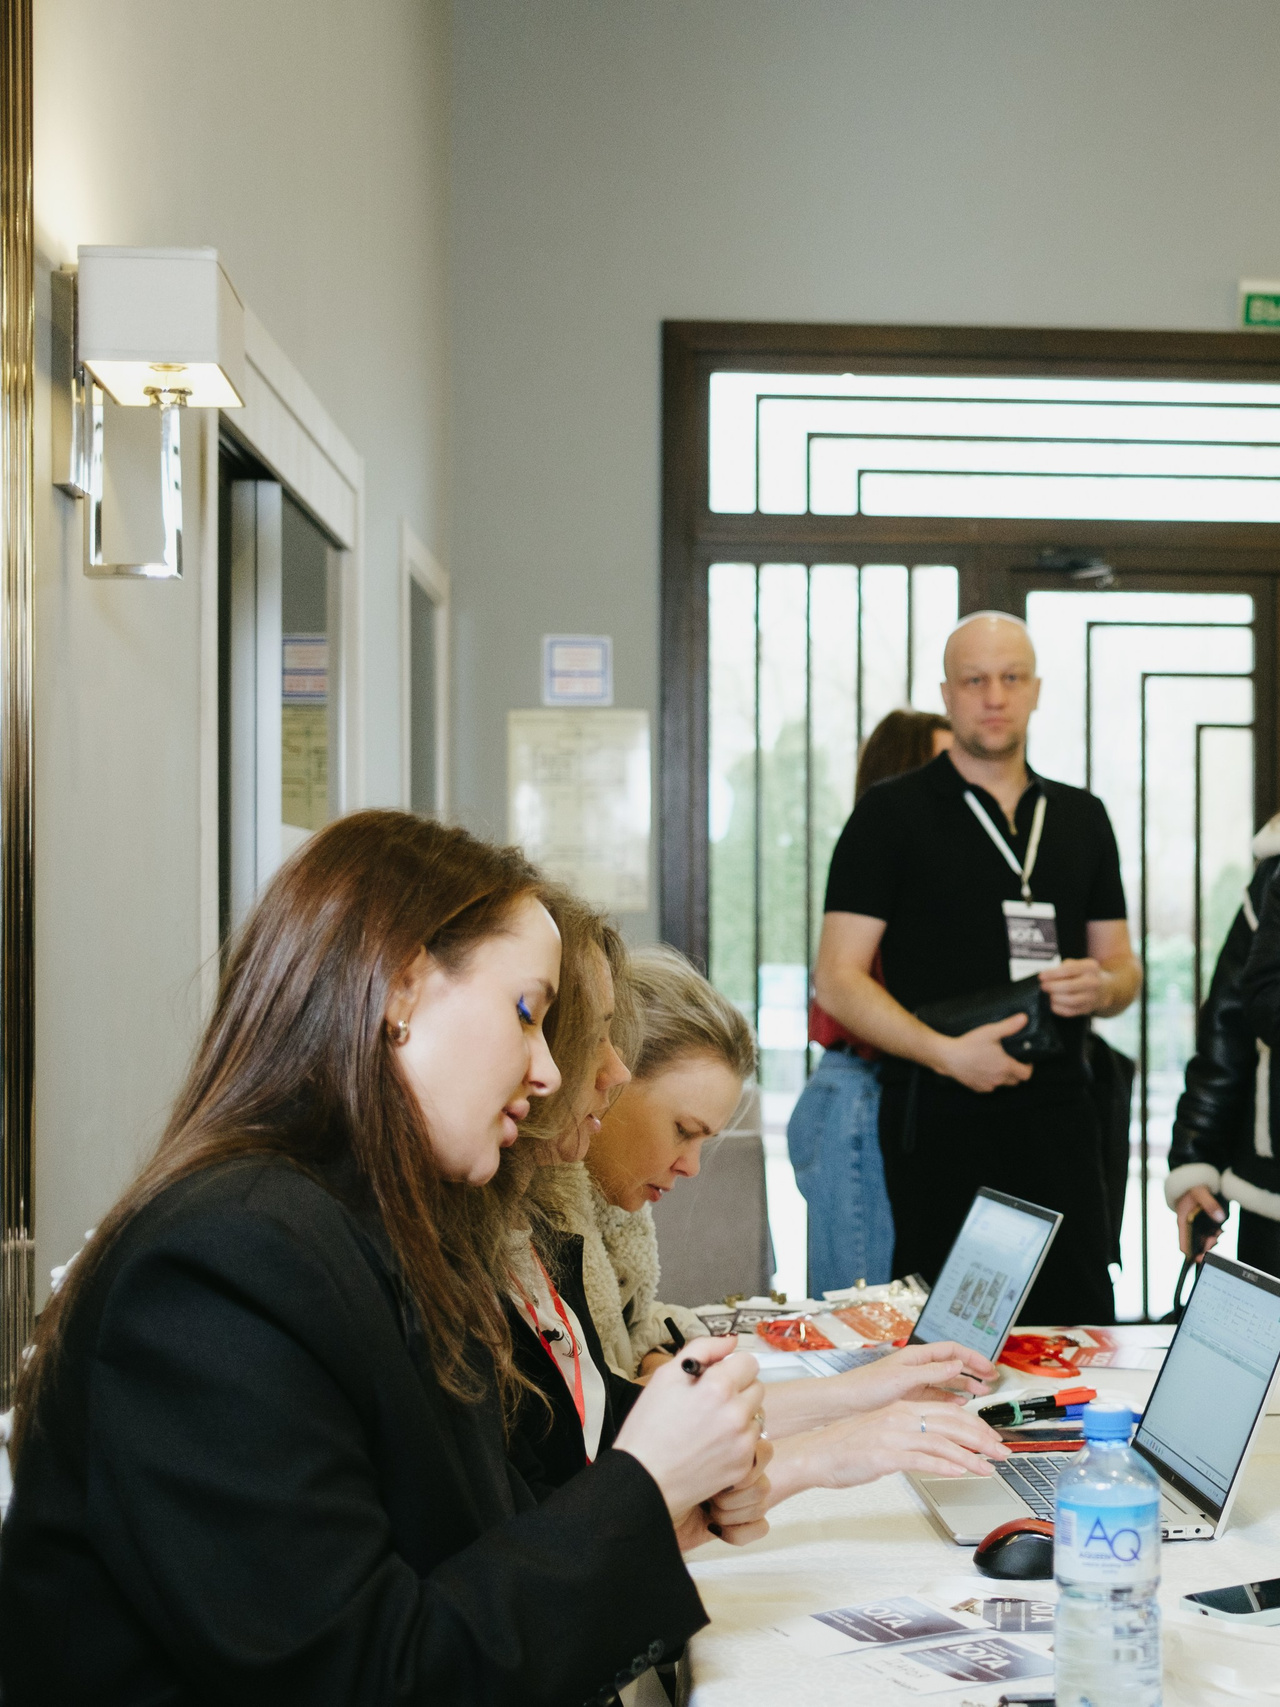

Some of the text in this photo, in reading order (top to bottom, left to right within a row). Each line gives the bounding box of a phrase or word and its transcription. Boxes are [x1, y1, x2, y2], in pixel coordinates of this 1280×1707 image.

[1084, 1516, 1141, 1561] AQ
[856, 1602, 913, 1630] ЮГА
[948, 1643, 1012, 1670] ЮГА
